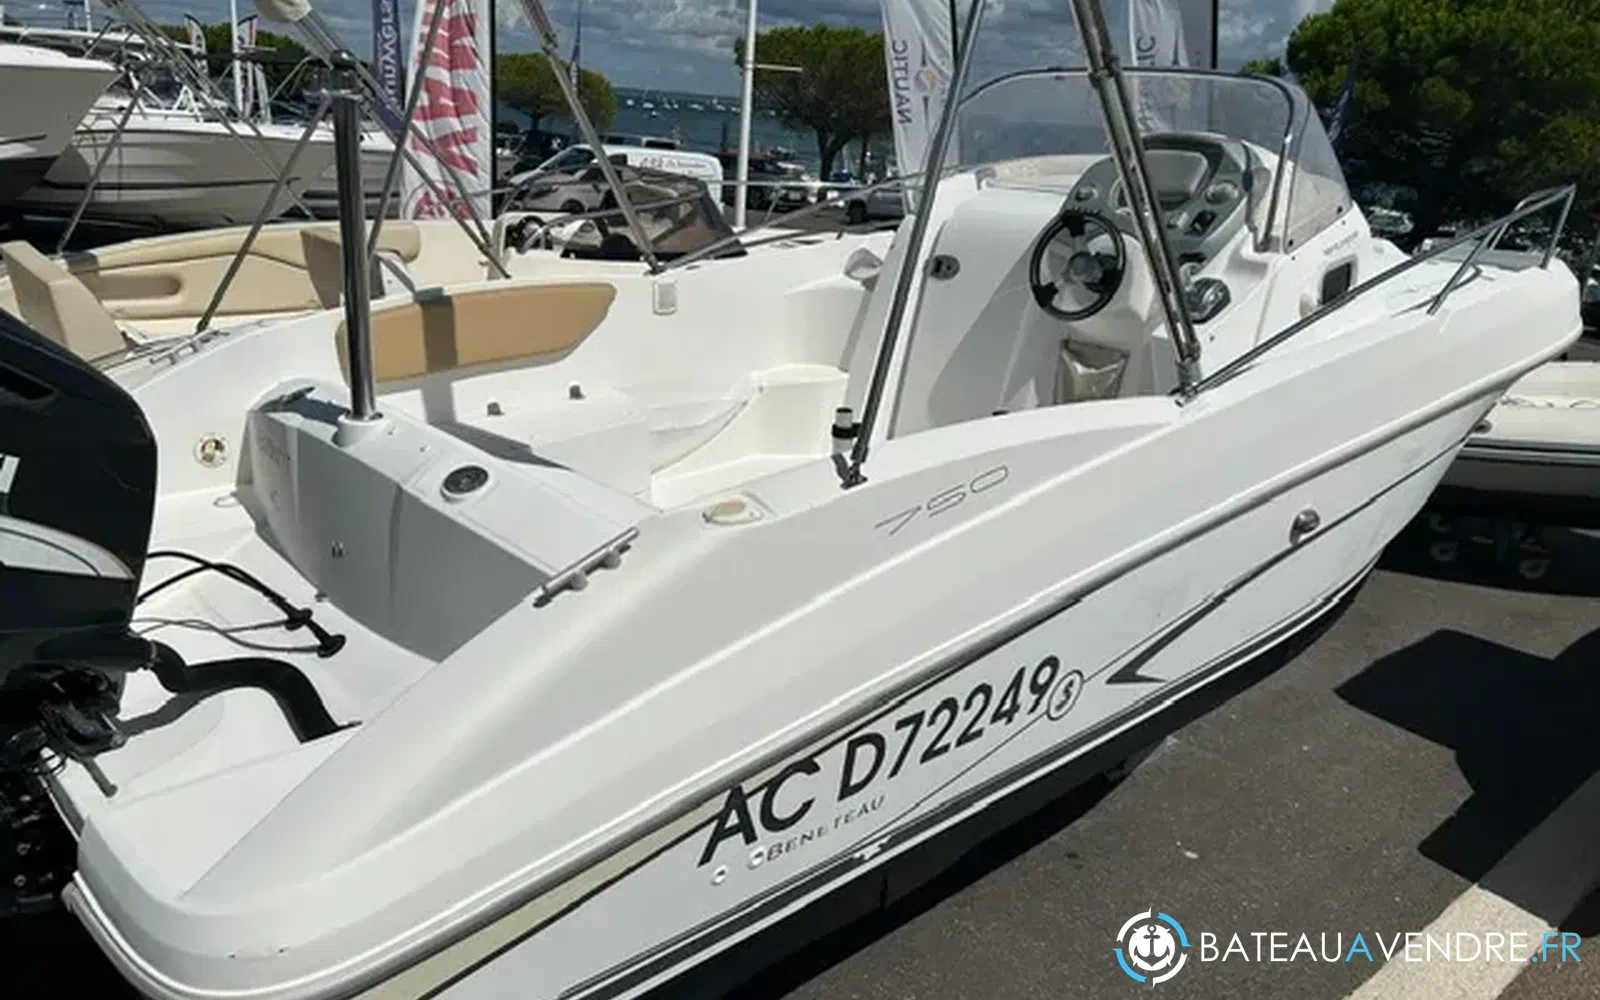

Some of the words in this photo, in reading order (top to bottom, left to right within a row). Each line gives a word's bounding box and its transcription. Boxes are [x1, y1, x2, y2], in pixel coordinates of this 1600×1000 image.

[874, 464, 1009, 536] 750
[697, 757, 821, 868] AC
[837, 655, 1061, 802] D72249
